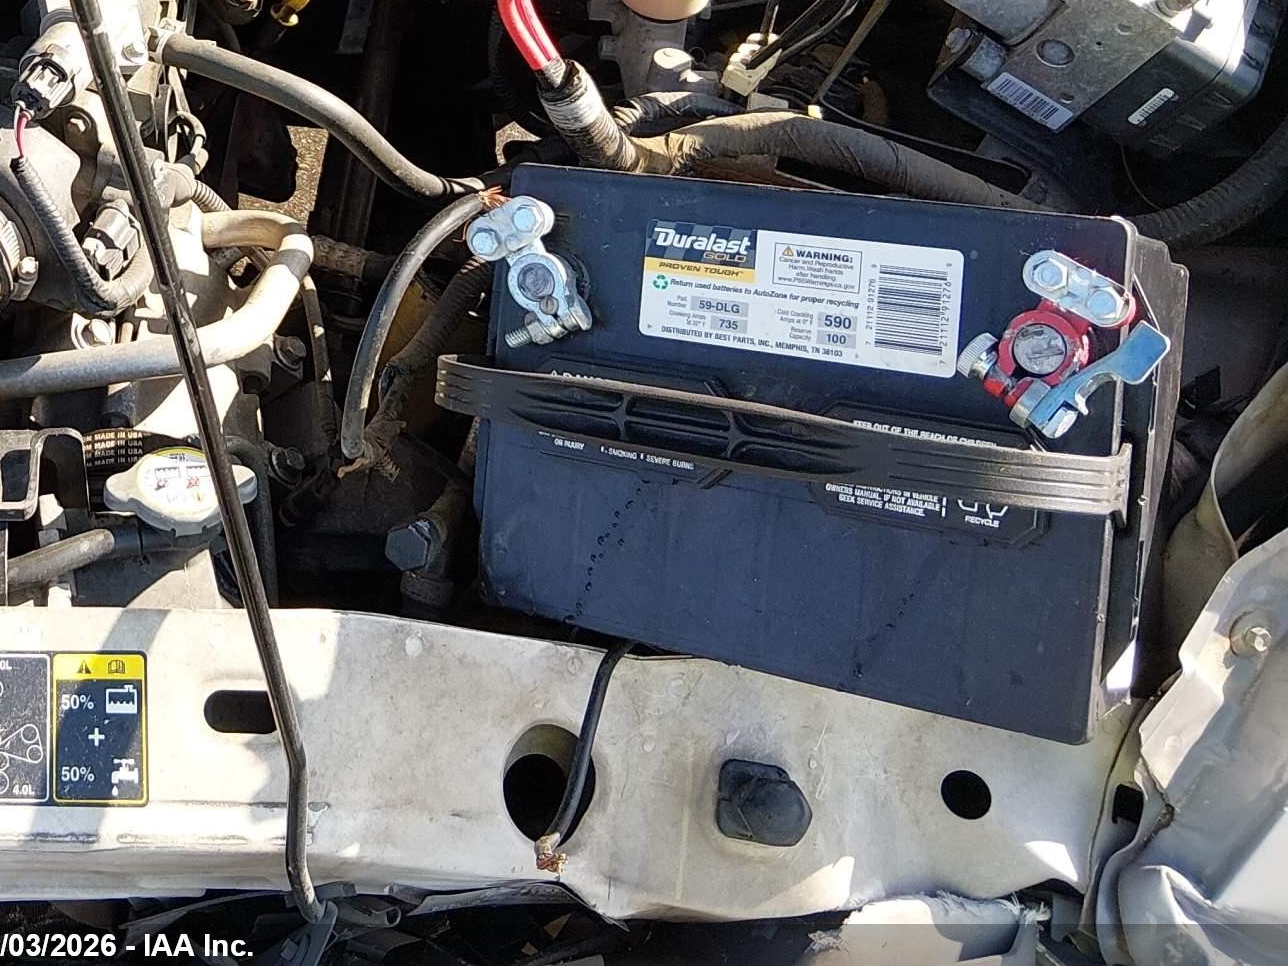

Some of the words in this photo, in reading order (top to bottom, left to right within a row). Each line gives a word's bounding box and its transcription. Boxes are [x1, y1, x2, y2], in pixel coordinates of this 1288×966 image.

[654, 228, 752, 254] Duralast
[703, 252, 746, 263] GOLD
[796, 250, 853, 263] WARNING:
[659, 262, 701, 272] PROVEN
[815, 260, 854, 270] Reproductive
[670, 279, 693, 287] Return
[695, 282, 711, 290] used
[712, 284, 742, 294] batteries
[753, 290, 787, 299] AutoZone
[800, 295, 824, 304] proper
[826, 298, 859, 309] recycling
[942, 282, 952, 310] 91276
[699, 300, 740, 313] 59-DLG
[720, 319, 738, 330] 735
[824, 315, 852, 329] 590
[940, 316, 949, 346] 21112
[662, 326, 703, 338] DISTRIBUTED
[704, 331, 713, 339] BY
[715, 333, 731, 341] BEST
[733, 335, 756, 345] PARTS,
[775, 341, 810, 353] MEMPHIS,
[812, 346, 820, 354] TN
[826, 334, 846, 344] 100
[94, 432, 115, 440] MADE
[94, 440, 115, 449] MADE
[554, 438, 563, 446] OR
[564, 440, 584, 450] INJURY
[608, 448, 637, 459] SMOKING
[646, 455, 671, 466] SEVERE
[672, 460, 694, 470] BURNS
[826, 483, 852, 494] OWNERS
[892, 494, 905, 504] NOT
[907, 498, 940, 511] AVAILABLE
[913, 492, 938, 503] VEHICLE
[839, 494, 855, 504] SEEK
[857, 497, 882, 509] SERVICE
[885, 502, 926, 517] ASSISTANCE.
[965, 515, 1000, 527] RECYCLE
[62, 694, 94, 709] 50%
[61, 767, 95, 782] 50%
[12, 784, 35, 795] 4.0L
